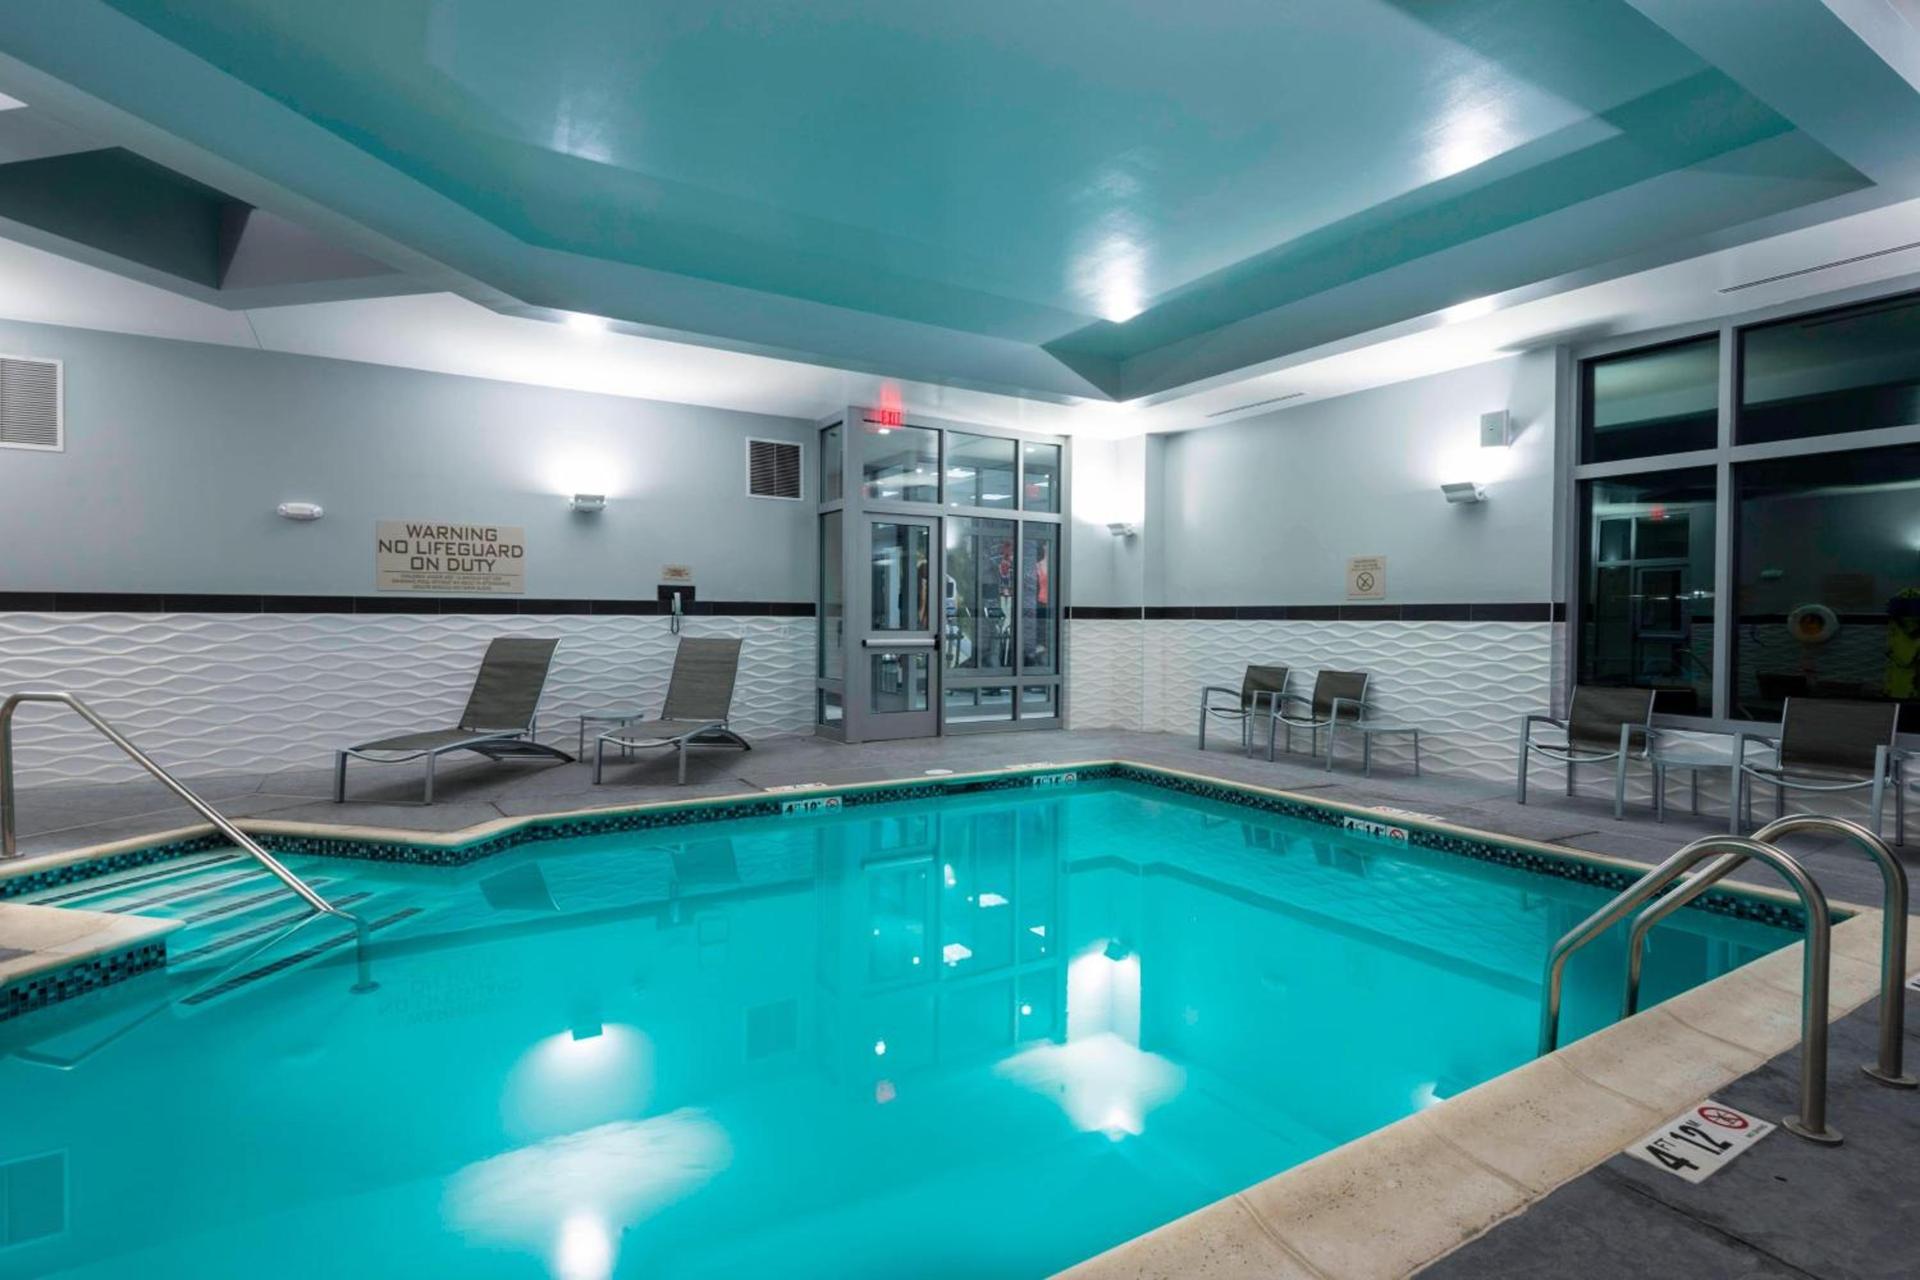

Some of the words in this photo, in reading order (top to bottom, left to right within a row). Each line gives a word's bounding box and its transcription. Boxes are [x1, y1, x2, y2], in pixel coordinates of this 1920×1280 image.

[881, 409, 901, 425] EXIT
[406, 524, 498, 542] WARNING
[379, 539, 408, 554] NO
[416, 541, 523, 558] LIFEGUARD
[410, 556, 439, 571] ON
[447, 558, 496, 572] DUTY
[1668, 1124, 1734, 1156] 12
[1645, 1144, 1699, 1171] 4
